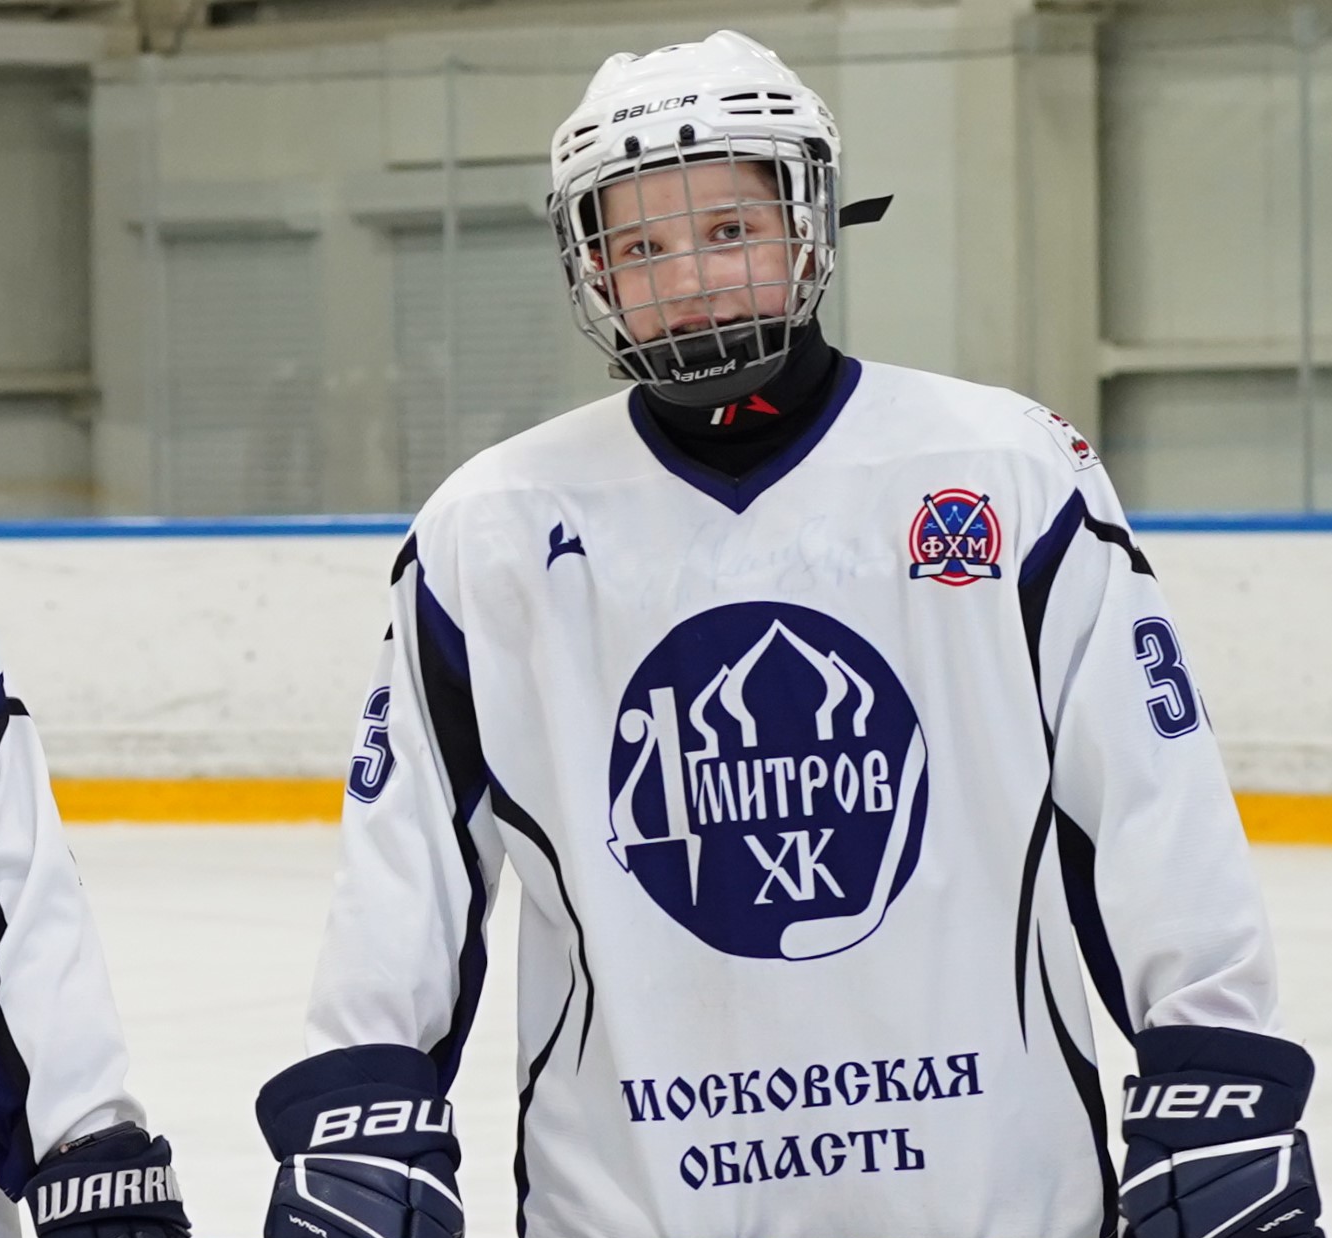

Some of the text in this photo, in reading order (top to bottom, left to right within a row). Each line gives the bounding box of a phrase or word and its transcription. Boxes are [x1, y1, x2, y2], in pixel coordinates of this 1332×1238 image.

[612, 95, 699, 124] BAUER
[921, 536, 988, 559] ФХМ
[1133, 617, 1214, 739] 3
[743, 828, 846, 905] ХК
[307, 1099, 457, 1149] BAU
[1123, 1084, 1263, 1121] UER
[679, 1128, 926, 1190] ОБЛАСТЬ
[37, 1165, 184, 1225] WARRI
